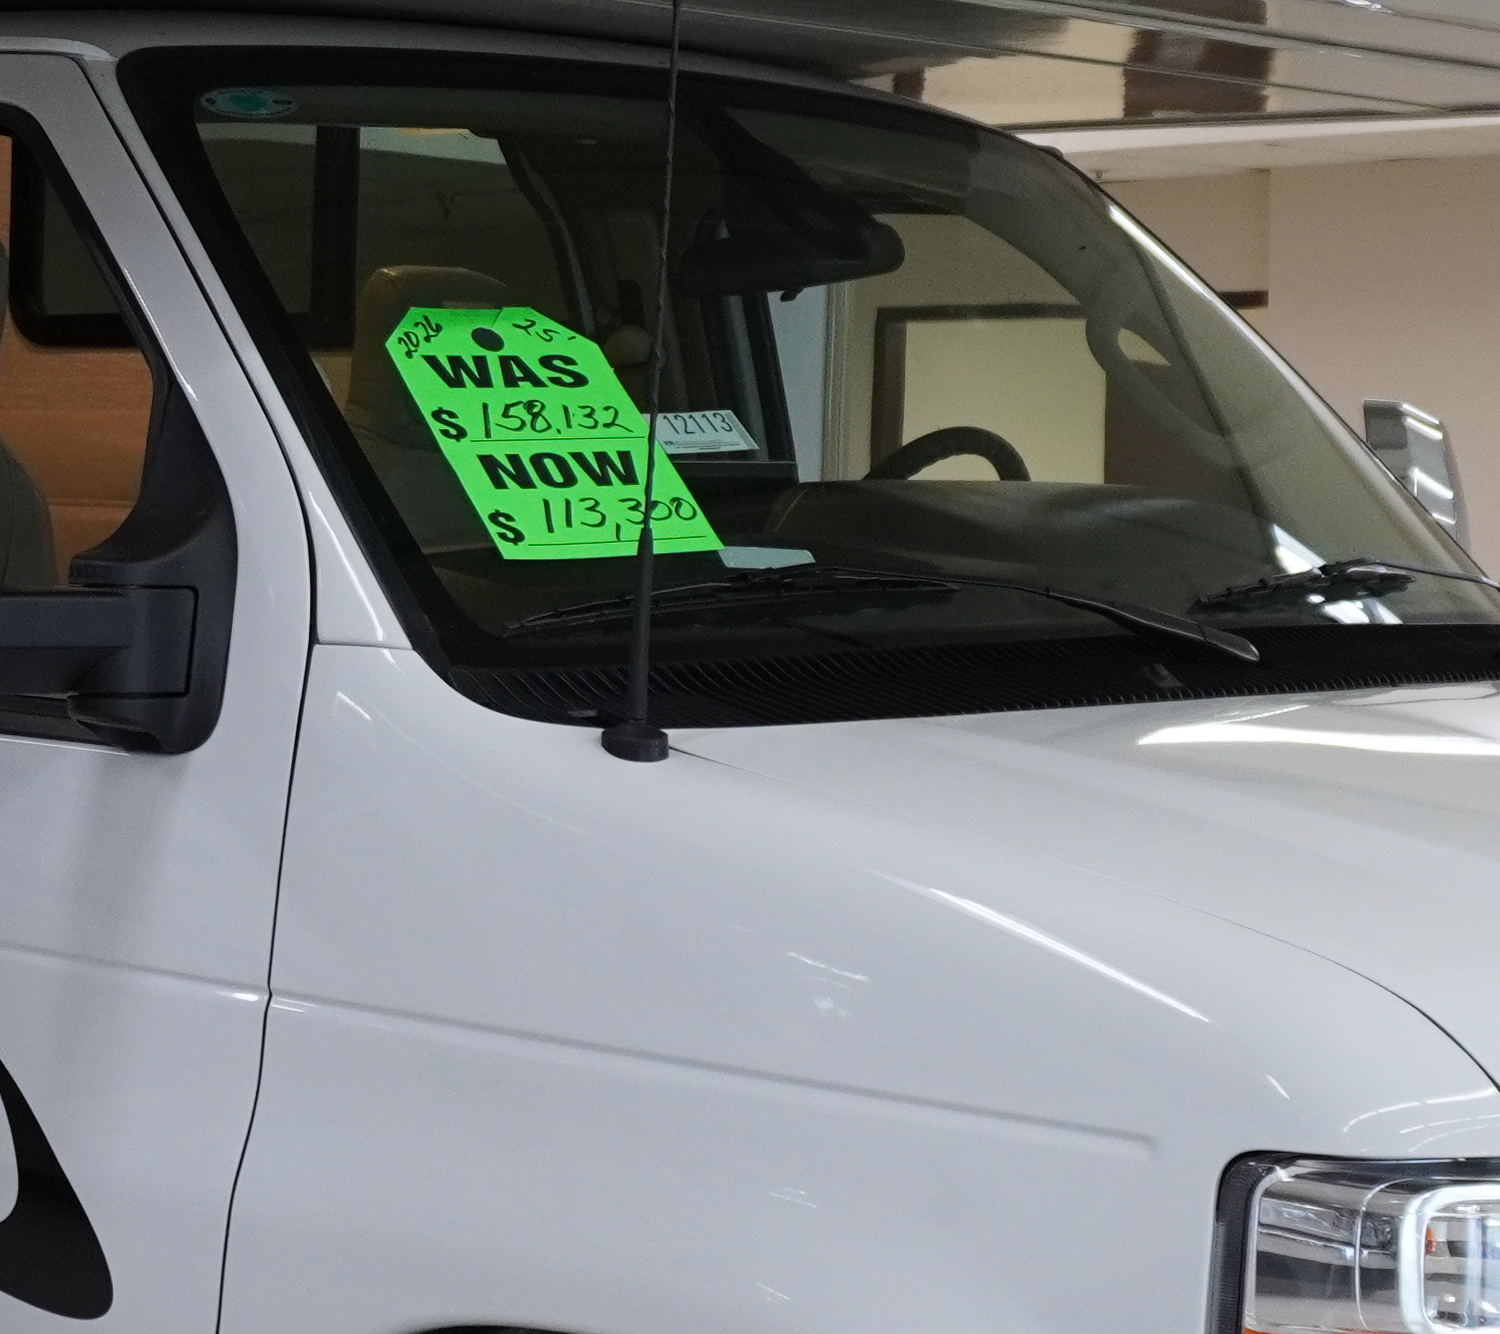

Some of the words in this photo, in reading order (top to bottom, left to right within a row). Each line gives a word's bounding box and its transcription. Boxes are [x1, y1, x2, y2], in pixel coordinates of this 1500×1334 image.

[397, 314, 444, 359] 2026
[421, 354, 590, 389] WAS
[662, 411, 733, 435] 12113
[477, 450, 639, 490] NOW
